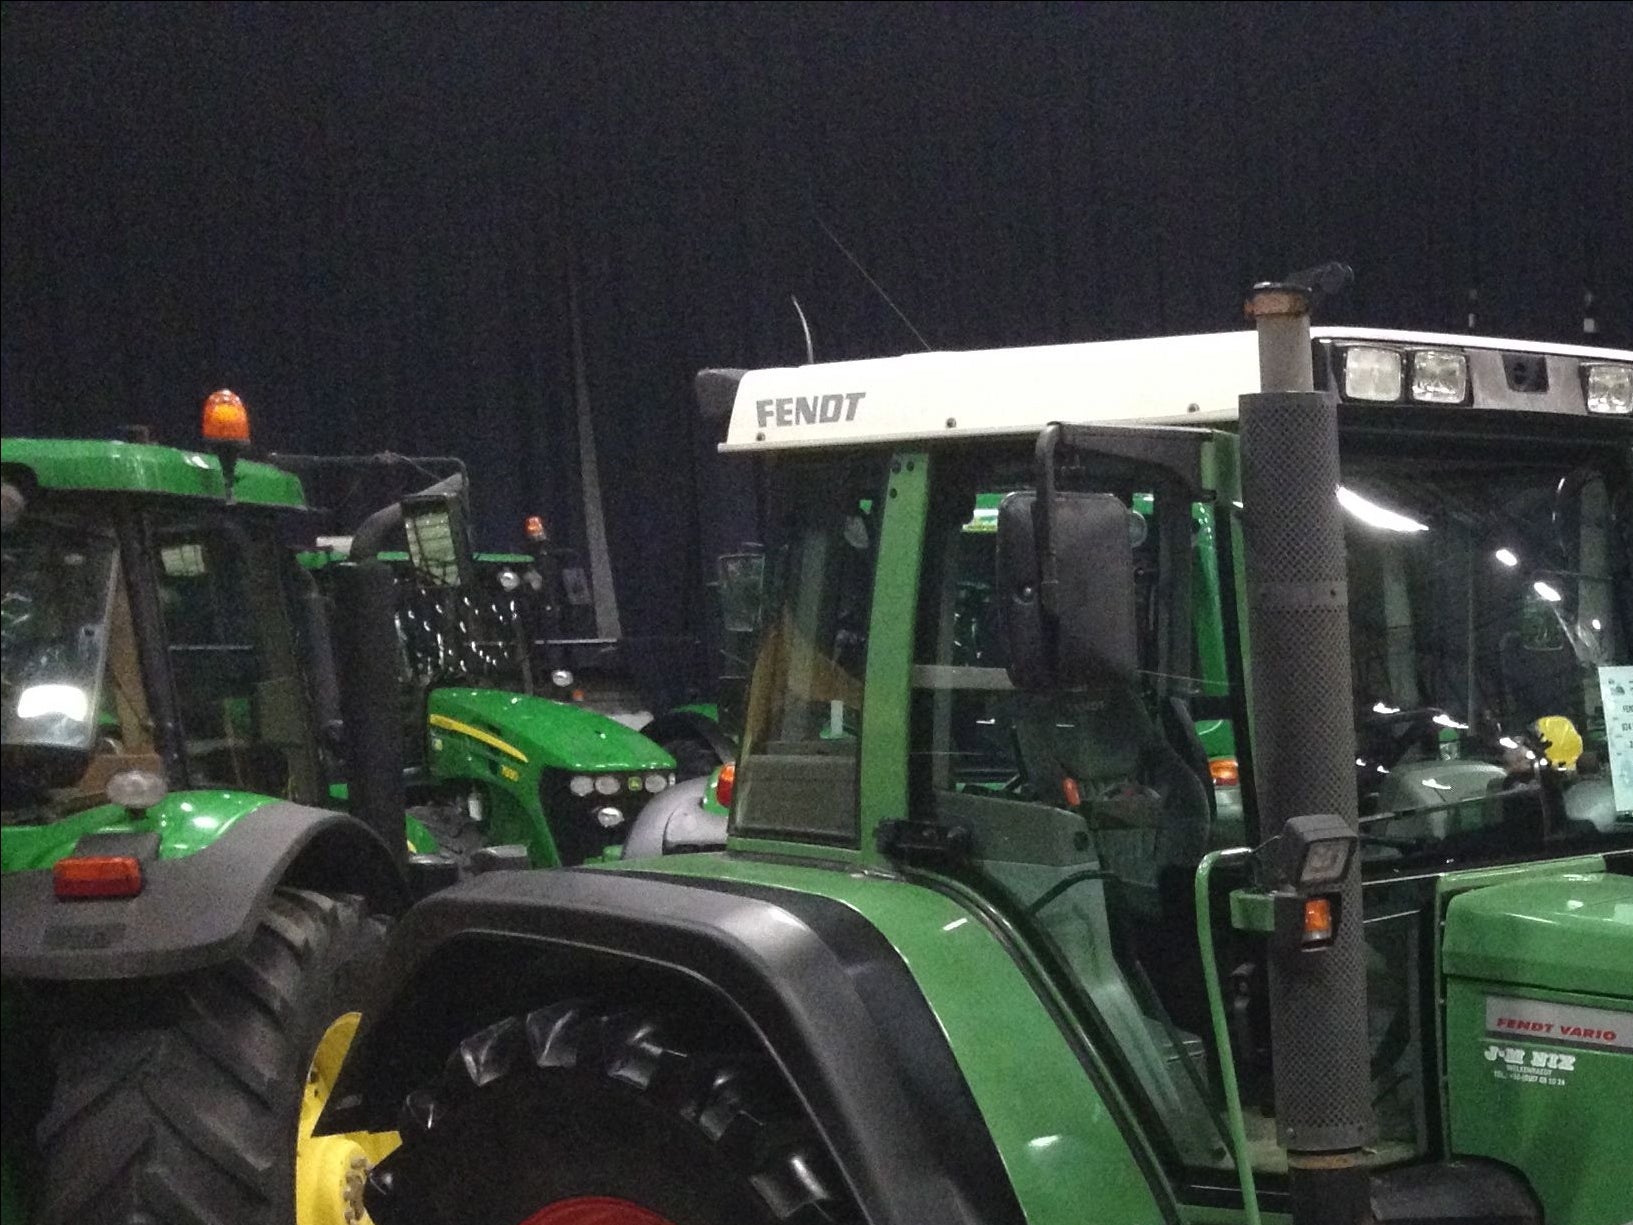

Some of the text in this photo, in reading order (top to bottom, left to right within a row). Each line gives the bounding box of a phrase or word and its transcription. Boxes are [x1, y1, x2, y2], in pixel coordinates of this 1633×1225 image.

[756, 392, 866, 428] FENDT
[1496, 1018, 1617, 1041] FENDT VARIO
